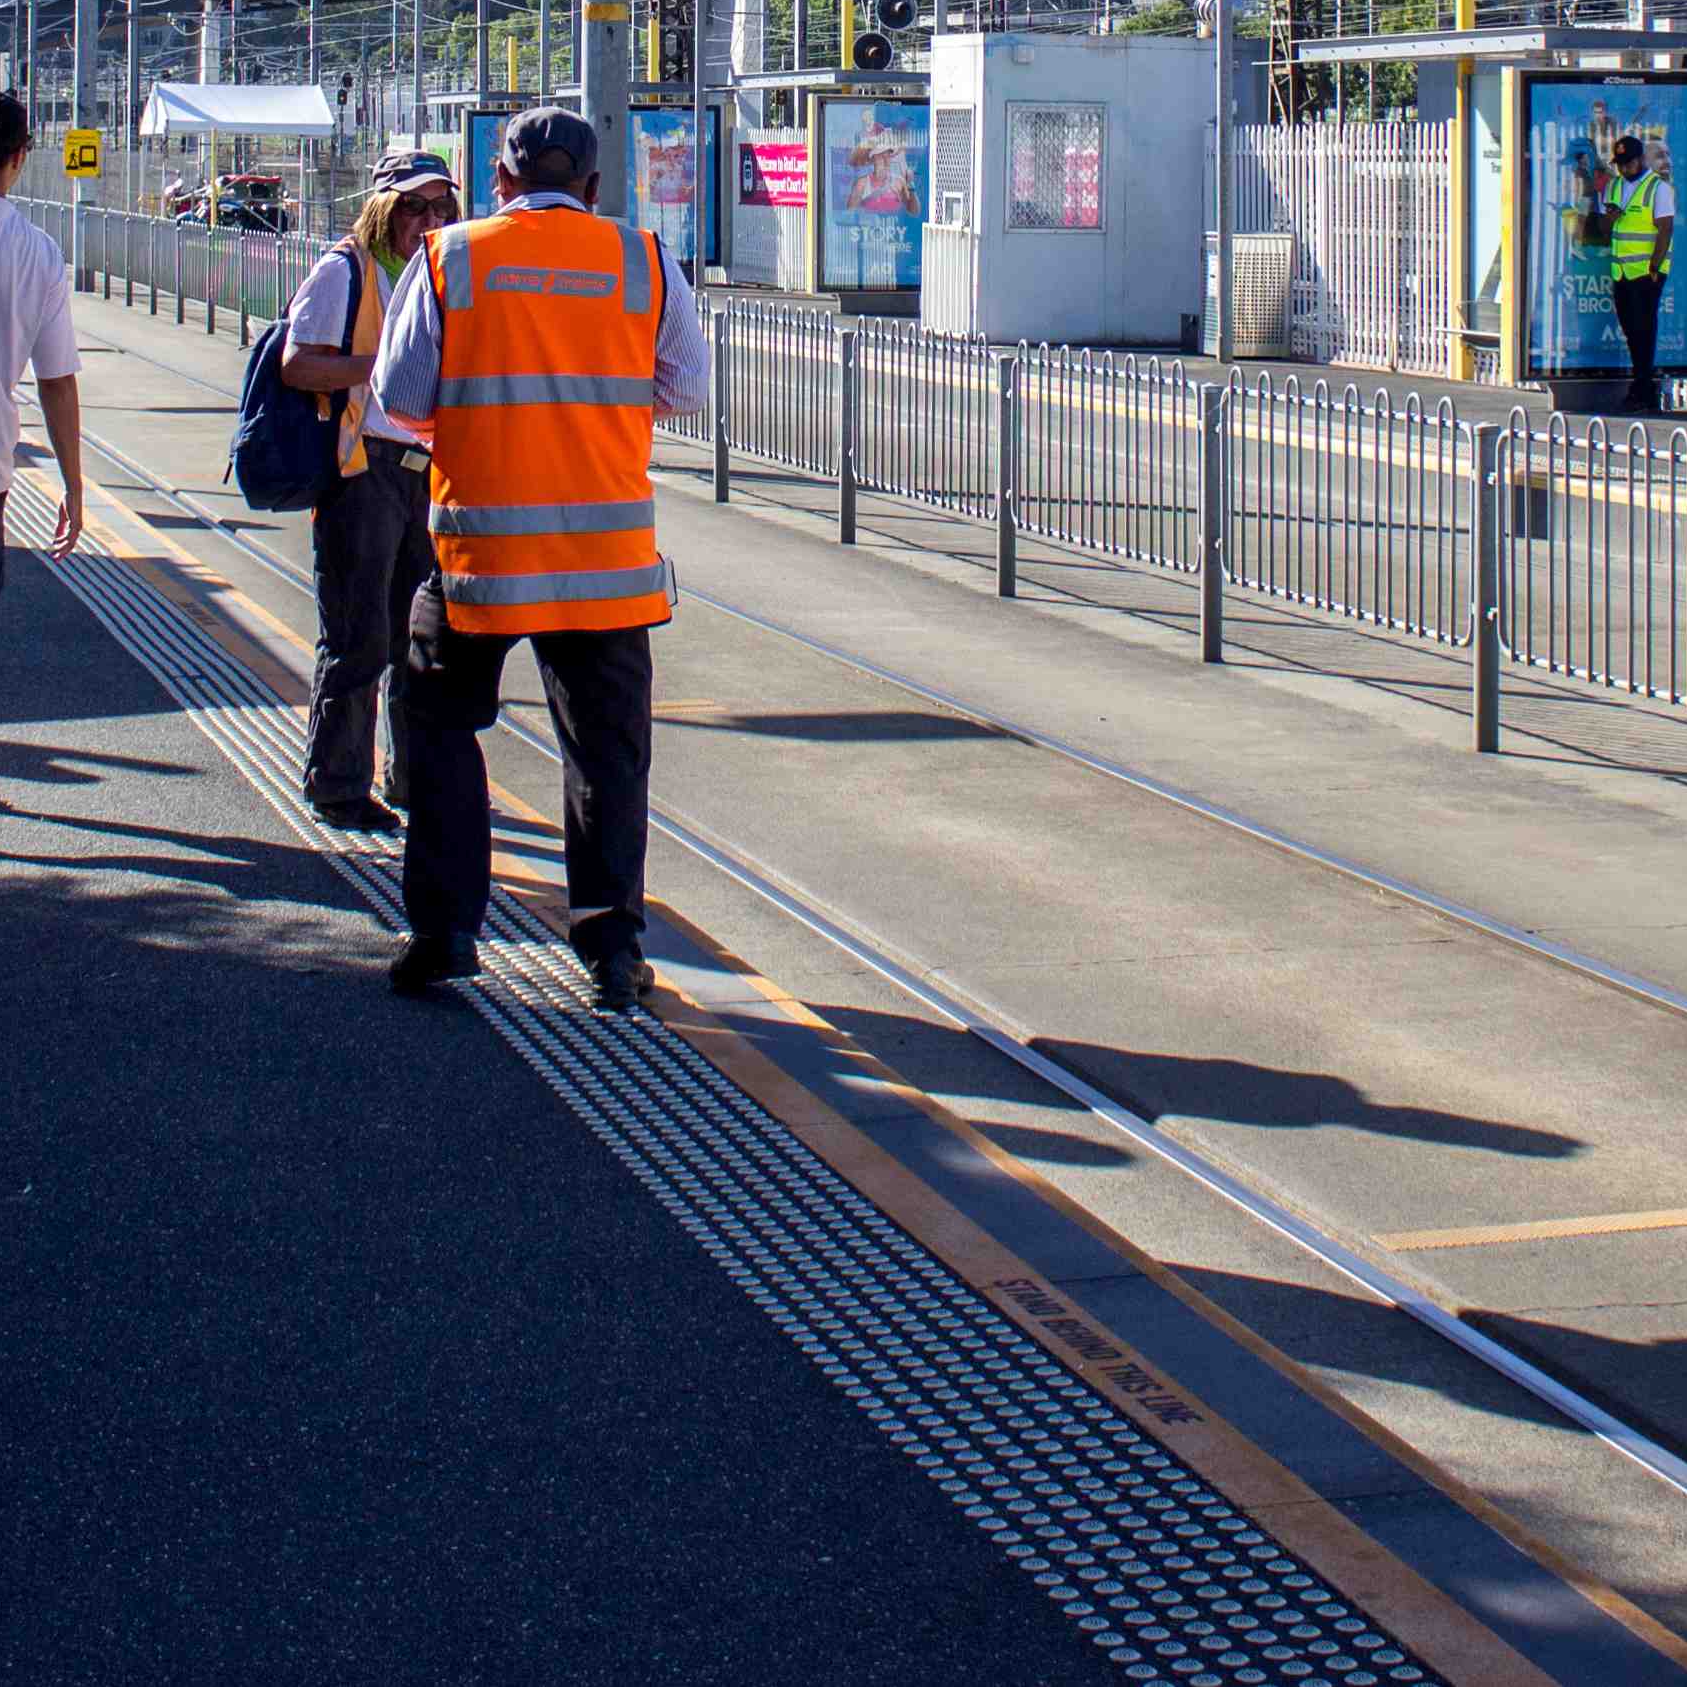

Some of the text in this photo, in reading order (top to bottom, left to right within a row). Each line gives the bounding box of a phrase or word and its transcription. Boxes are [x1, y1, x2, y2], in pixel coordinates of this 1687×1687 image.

[849, 224, 907, 243] STORY
[993, 1278, 1207, 1425] STAND BEHIND THIS LINE
